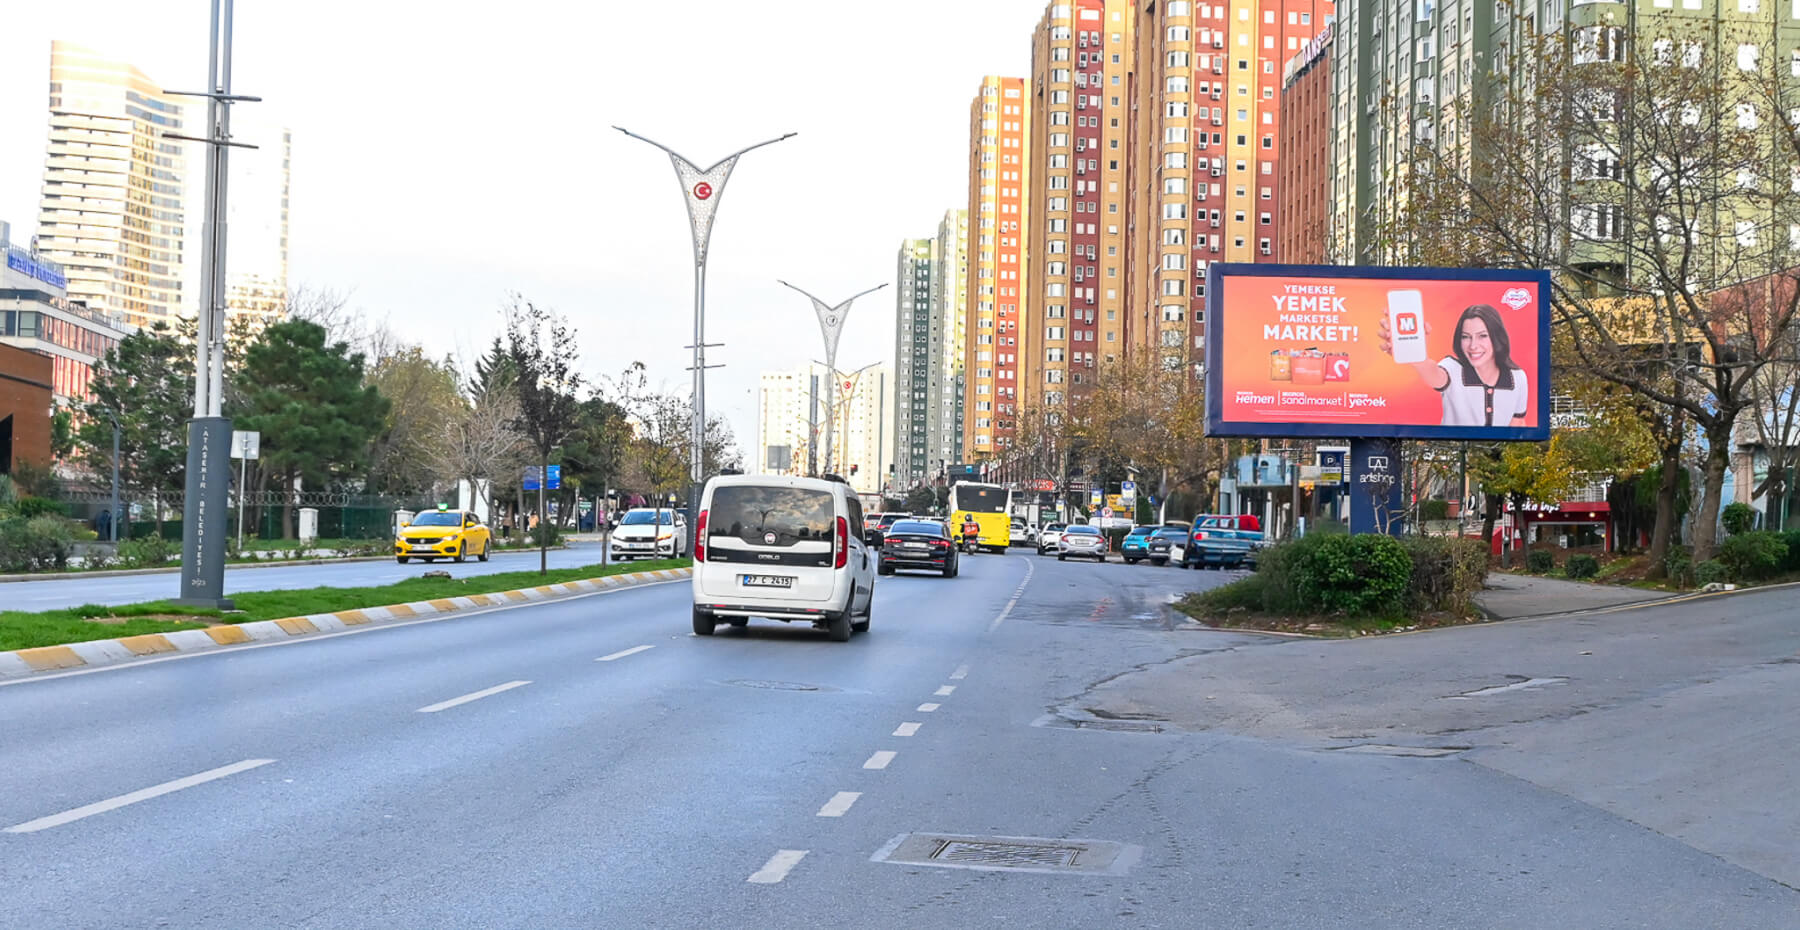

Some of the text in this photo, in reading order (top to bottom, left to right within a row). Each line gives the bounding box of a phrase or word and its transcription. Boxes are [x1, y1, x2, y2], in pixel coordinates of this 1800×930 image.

[1283, 284, 1336, 295] YEMEKSE
[1271, 295, 1347, 313] YEMEK
[1279, 313, 1340, 324] MARKETSE
[1263, 324, 1359, 342] MARKET!
[1235, 394, 1274, 404] Hemen
[1348, 396, 1386, 409] yemek
[761, 576, 767, 584] C
